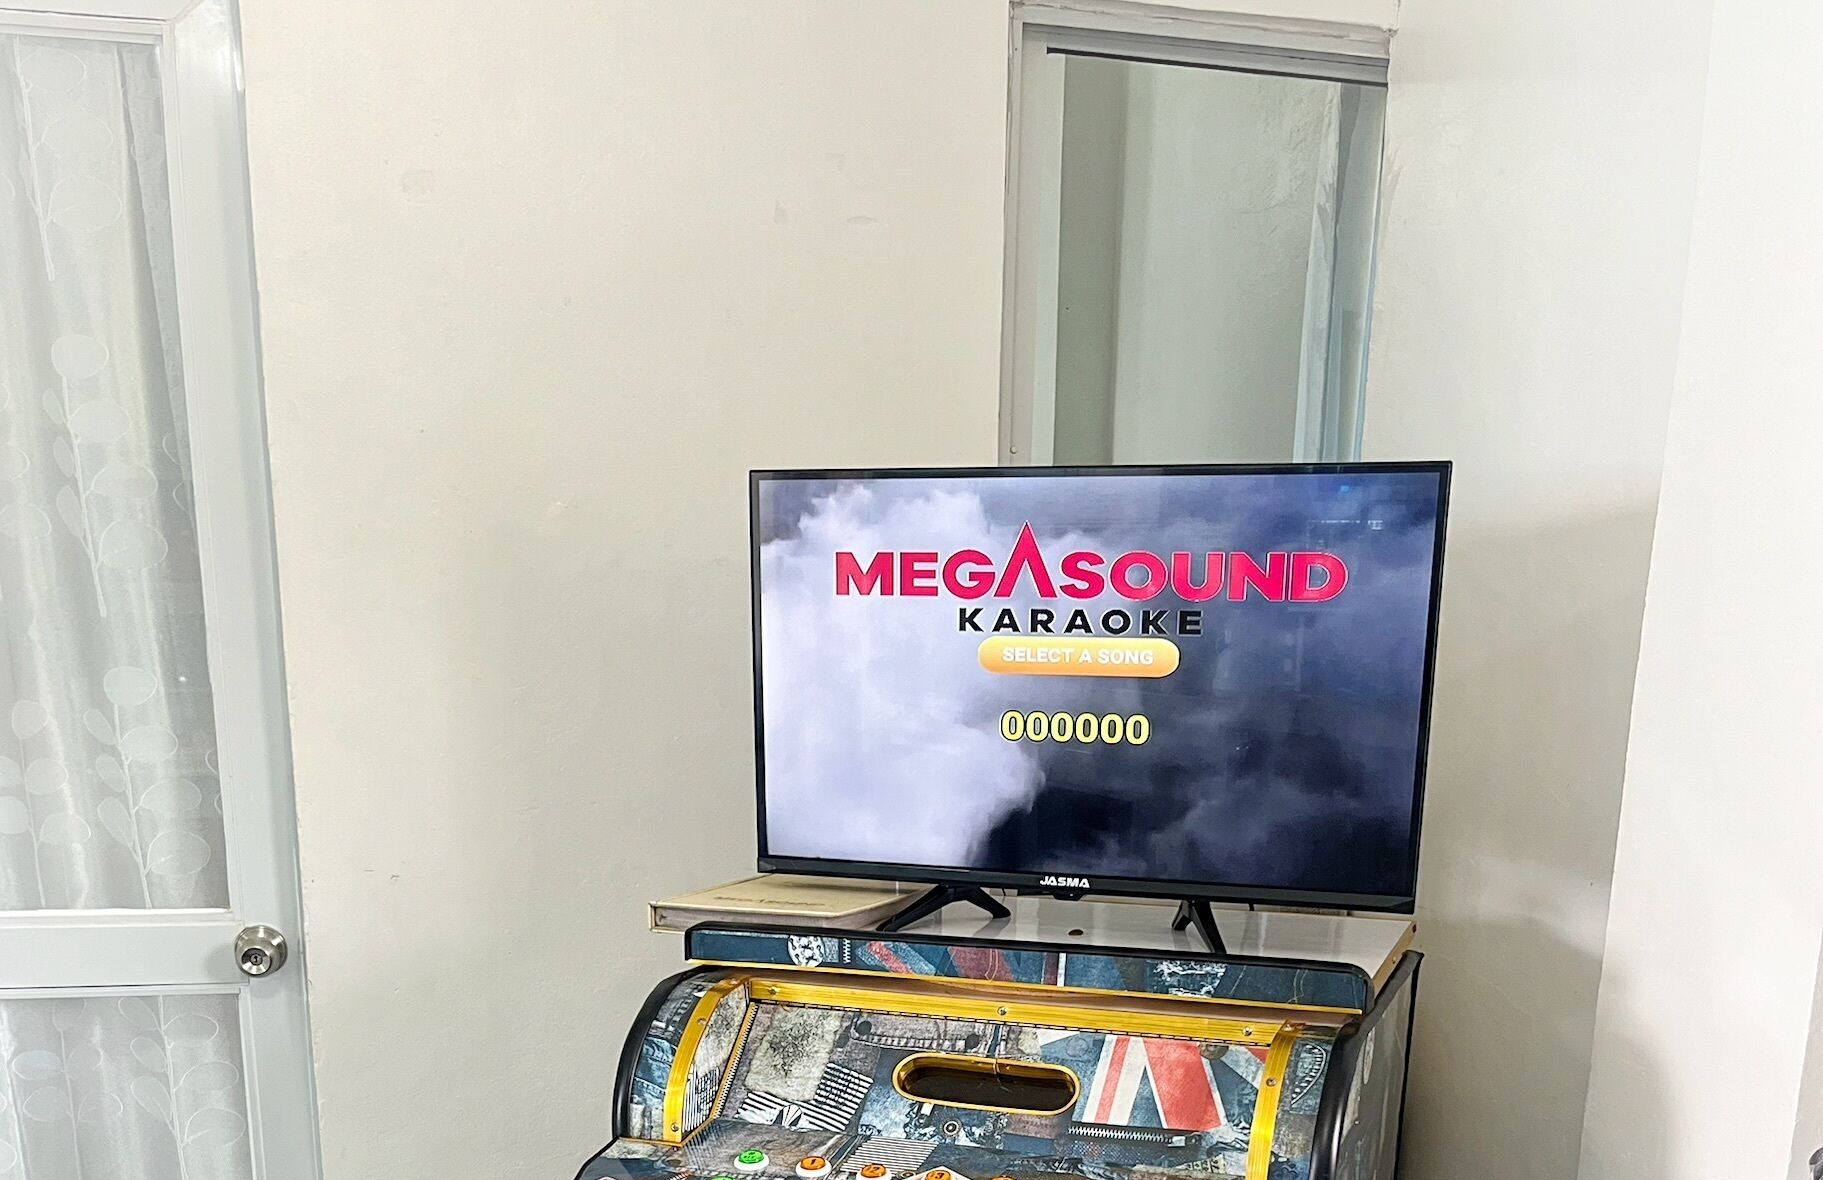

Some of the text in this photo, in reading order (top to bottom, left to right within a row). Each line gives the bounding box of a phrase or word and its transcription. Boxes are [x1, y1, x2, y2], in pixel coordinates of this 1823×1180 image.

[835, 521, 1349, 602] MEGASOUND
[958, 606, 1203, 636] KARAOKE
[1002, 646, 1154, 666] SELECT A SONG
[1000, 709, 1151, 746] 000000
[1039, 875, 1091, 889] JASMA
